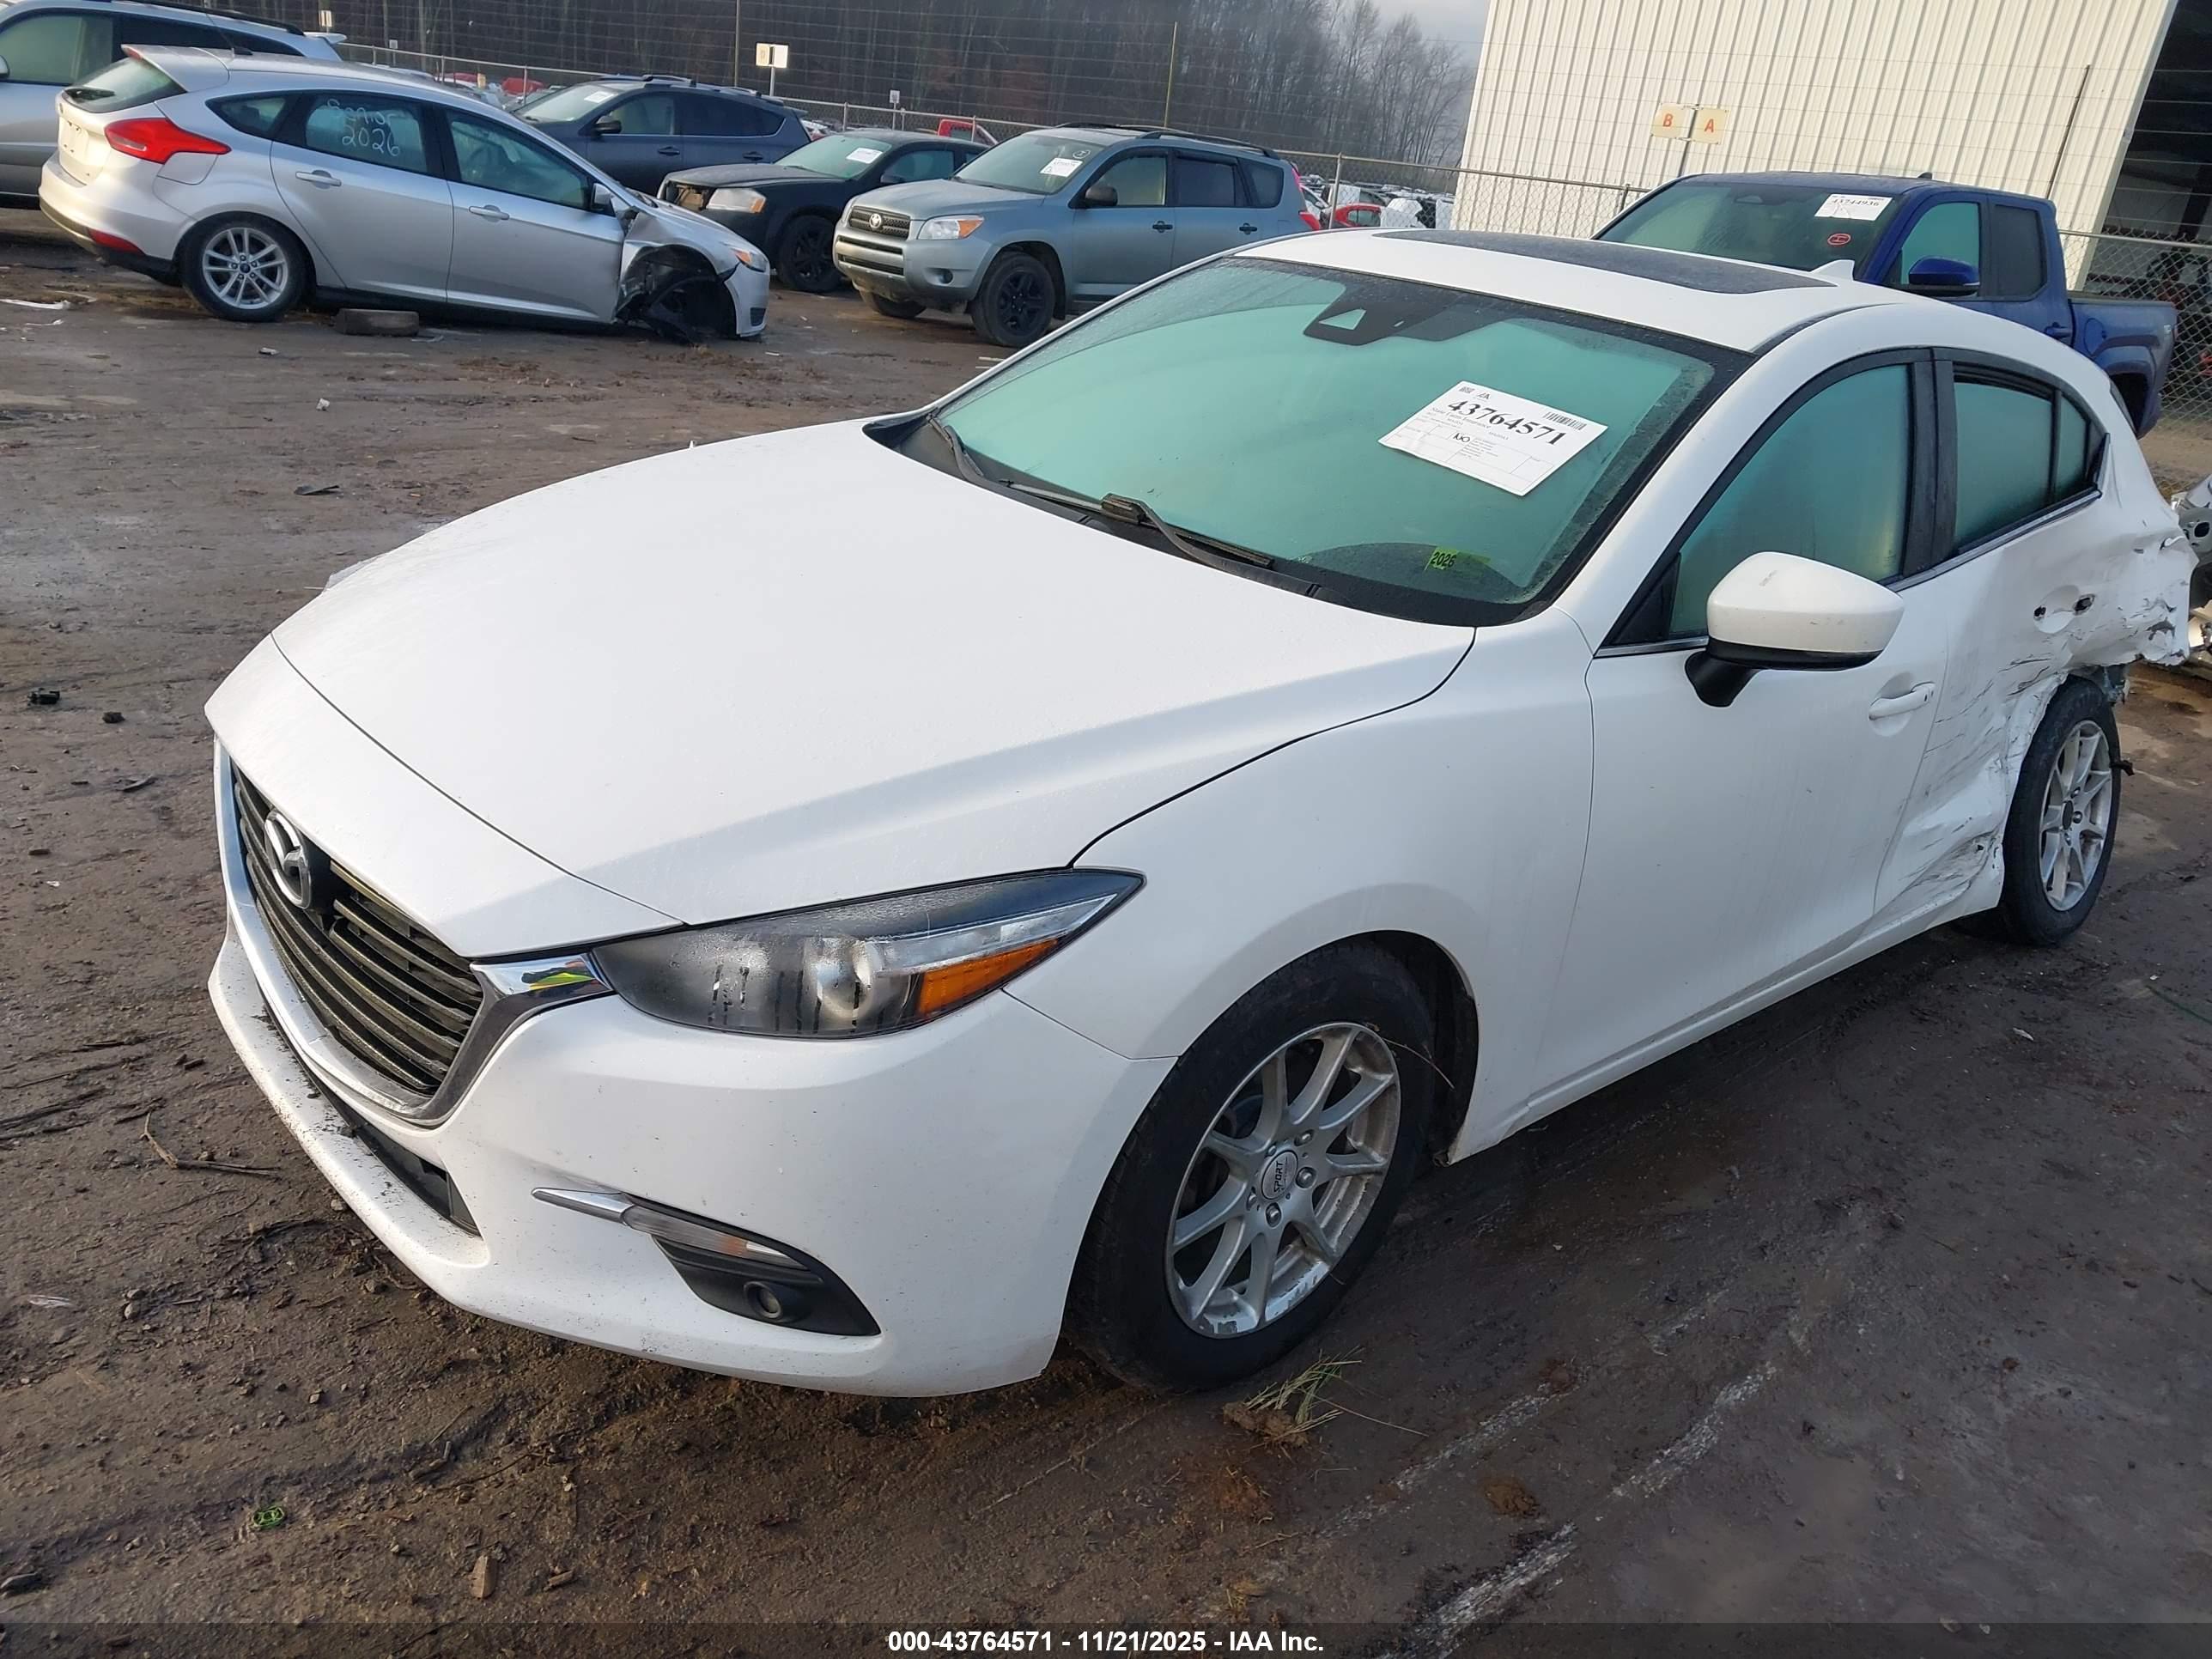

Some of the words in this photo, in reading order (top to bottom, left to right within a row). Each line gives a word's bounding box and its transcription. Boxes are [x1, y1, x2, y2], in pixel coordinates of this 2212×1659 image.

[1662, 113, 1674, 127] B
[1704, 118, 1715, 133] A
[342, 125, 400, 156] 2026
[1448, 401, 1567, 445] 43764571
[1274, 1161, 1284, 1192] SPORT
